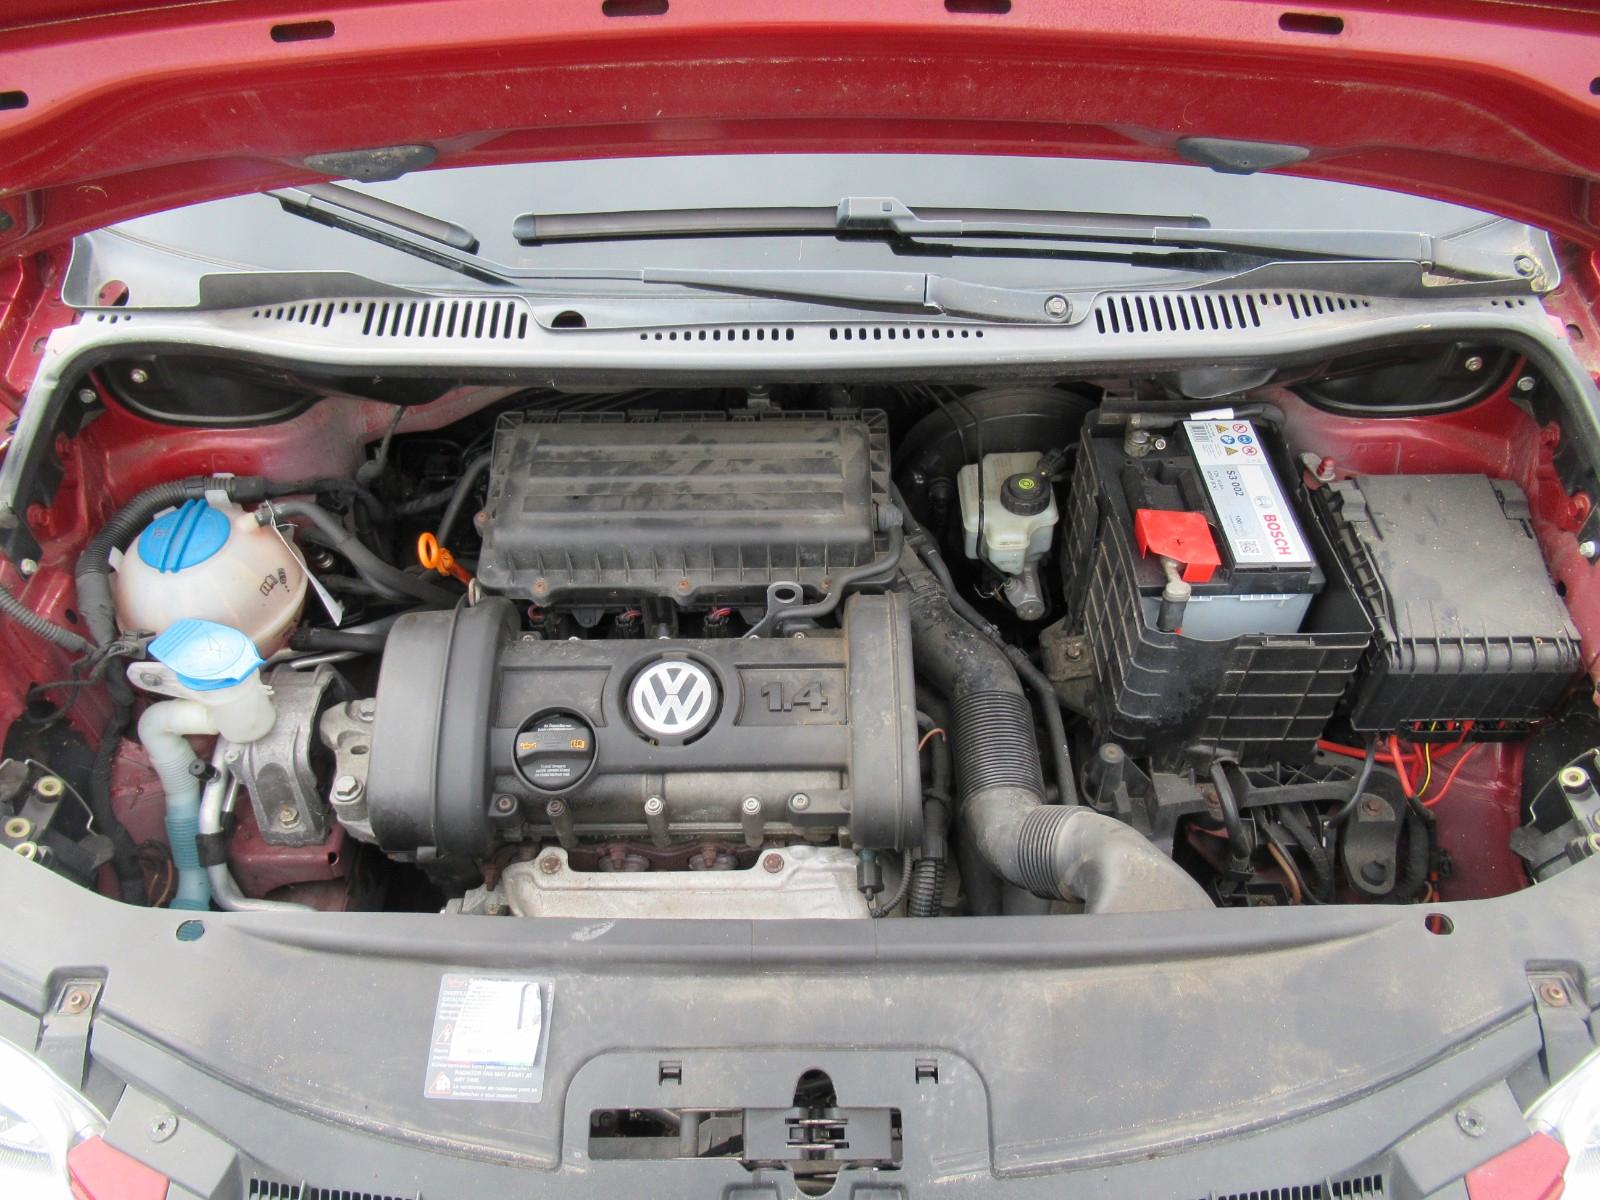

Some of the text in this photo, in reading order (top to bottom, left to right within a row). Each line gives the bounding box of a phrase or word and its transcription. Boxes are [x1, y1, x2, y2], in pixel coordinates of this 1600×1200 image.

[1226, 470, 1244, 497] S3 002
[1263, 514, 1292, 555] BOSCH
[633, 661, 711, 733] VW
[761, 681, 828, 712] 1.4
